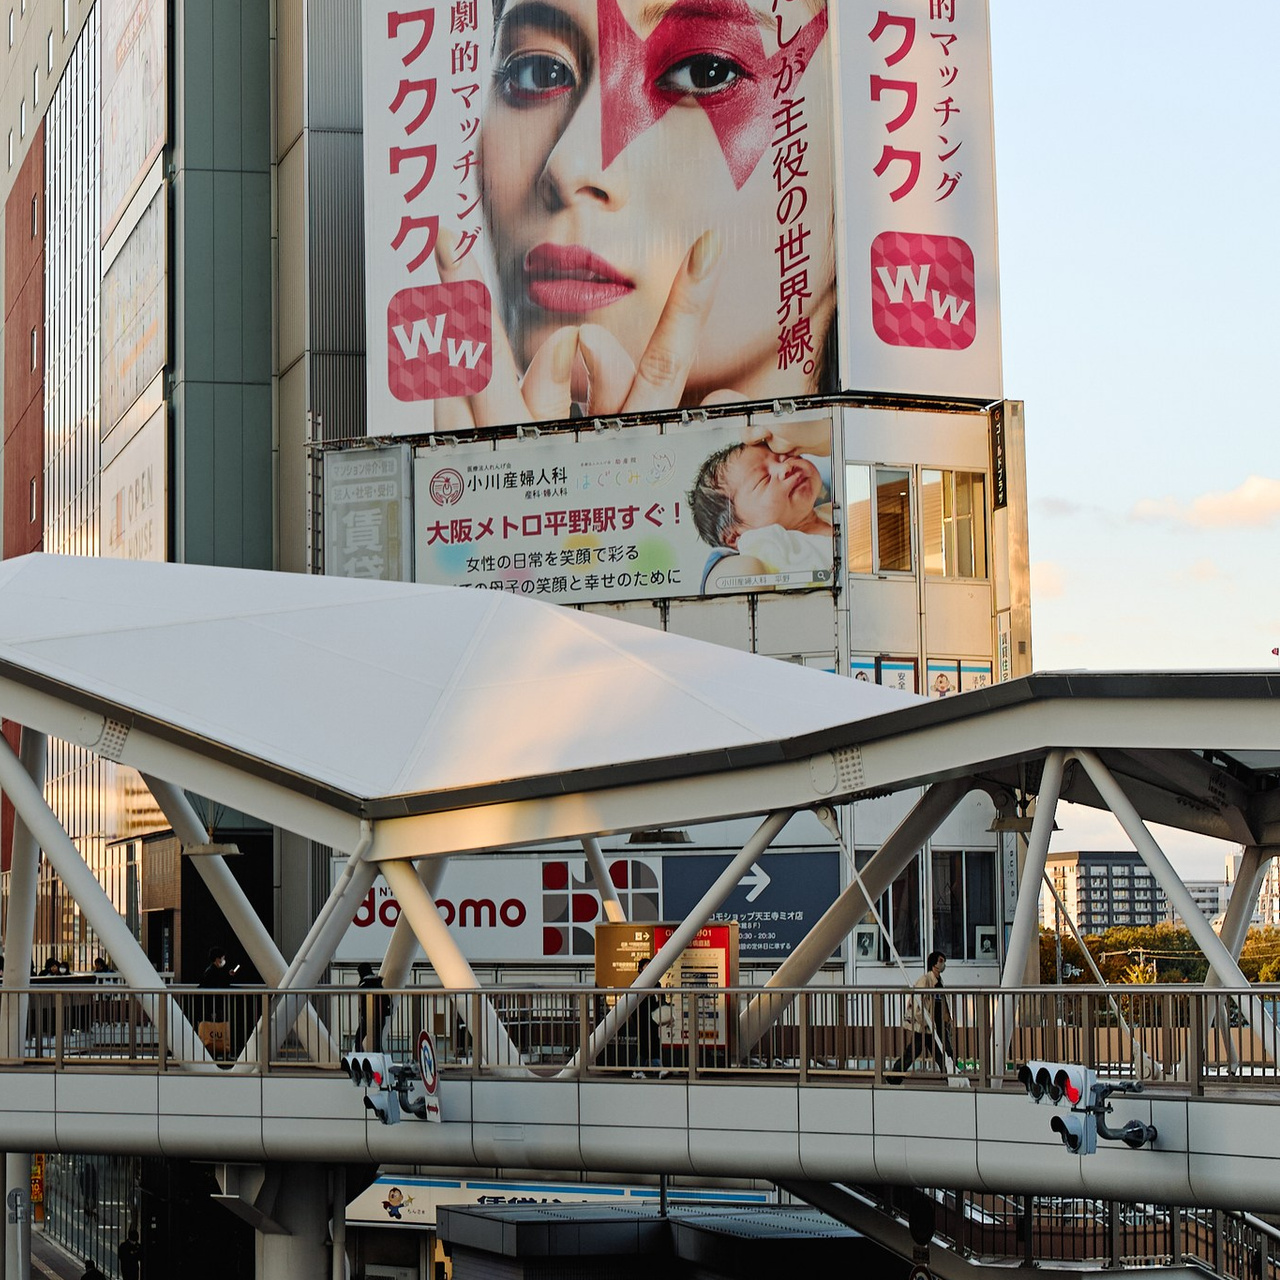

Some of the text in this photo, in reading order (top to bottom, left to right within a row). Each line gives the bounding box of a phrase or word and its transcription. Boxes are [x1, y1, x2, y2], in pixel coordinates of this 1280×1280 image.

[386, 7, 438, 275] ワクワク
[127, 463, 154, 523] OPEN
[467, 467, 568, 492] 小川産婦人科
[466, 545, 640, 574] 女性の日常を笑顔で彩る
[353, 887, 527, 929] doomo
